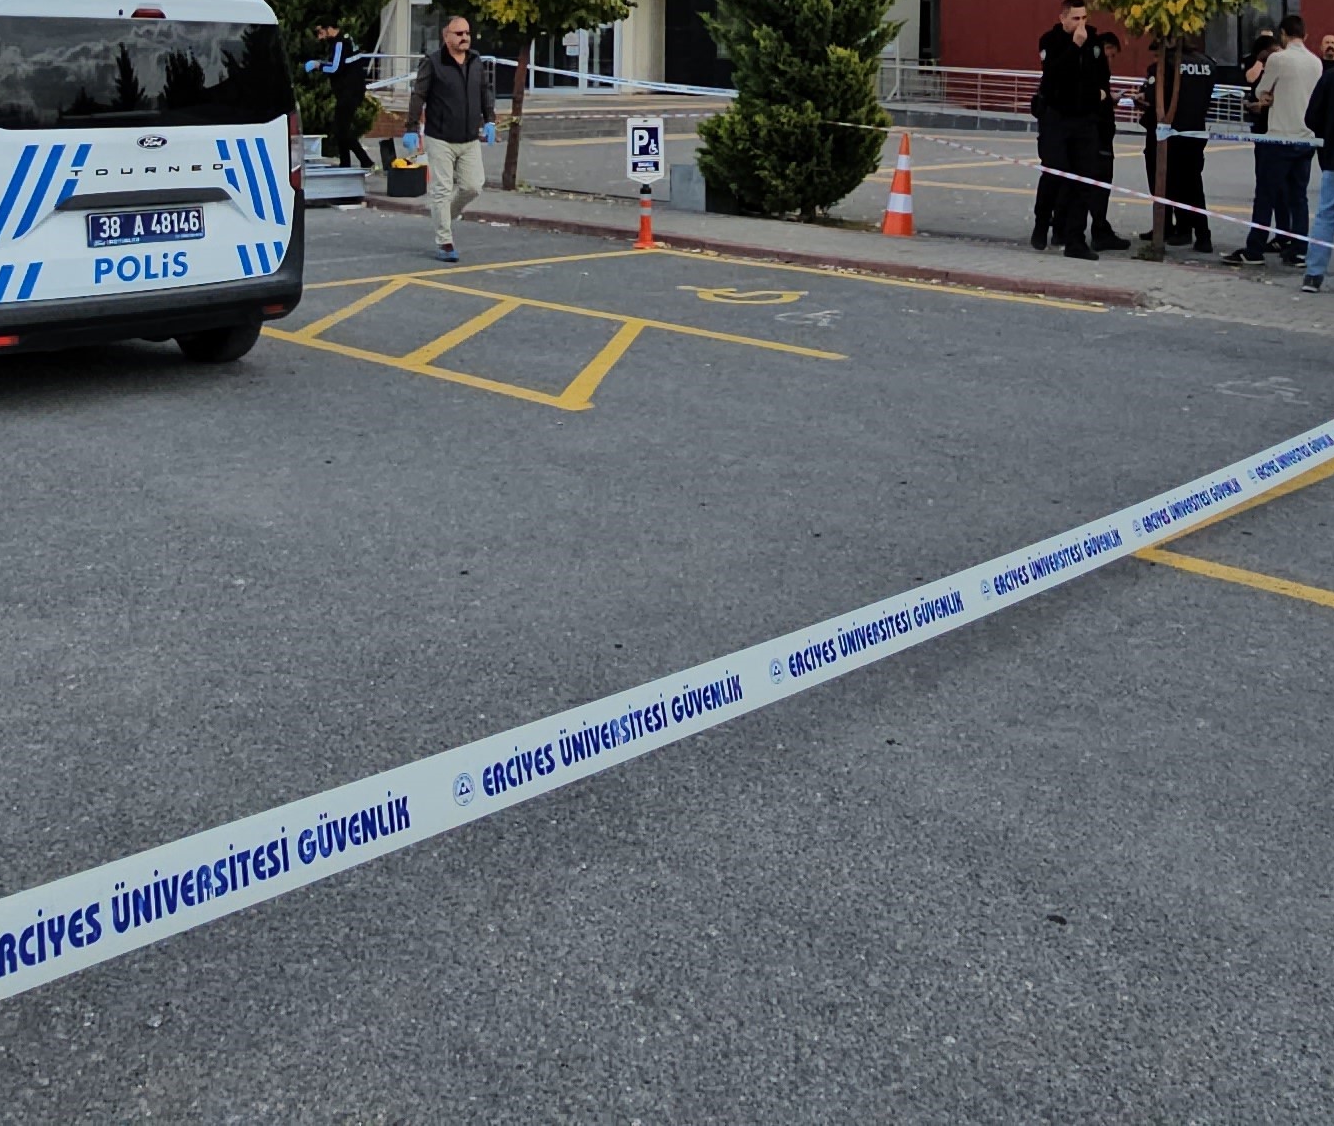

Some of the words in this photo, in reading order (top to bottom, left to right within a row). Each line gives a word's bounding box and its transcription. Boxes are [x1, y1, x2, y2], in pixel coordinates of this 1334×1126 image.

[71, 163, 223, 176] TOURNEO
[634, 129, 649, 154] P
[99, 216, 120, 238] 38
[133, 215, 144, 236] A
[151, 211, 199, 234] 48146
[789, 639, 837, 677] ERCİYES
[838, 603, 912, 657] ÜNİVERSİTESİ
[913, 587, 964, 627] GÜVENLİK
[483, 746, 556, 796] ERCİYES
[559, 693, 668, 766] ÜNİVERSİTESİ
[672, 670, 743, 723] GÜVENLİK
[111, 826, 289, 934] ÜNİVERSİTESİ
[298, 791, 410, 864] GÜVENLİK
